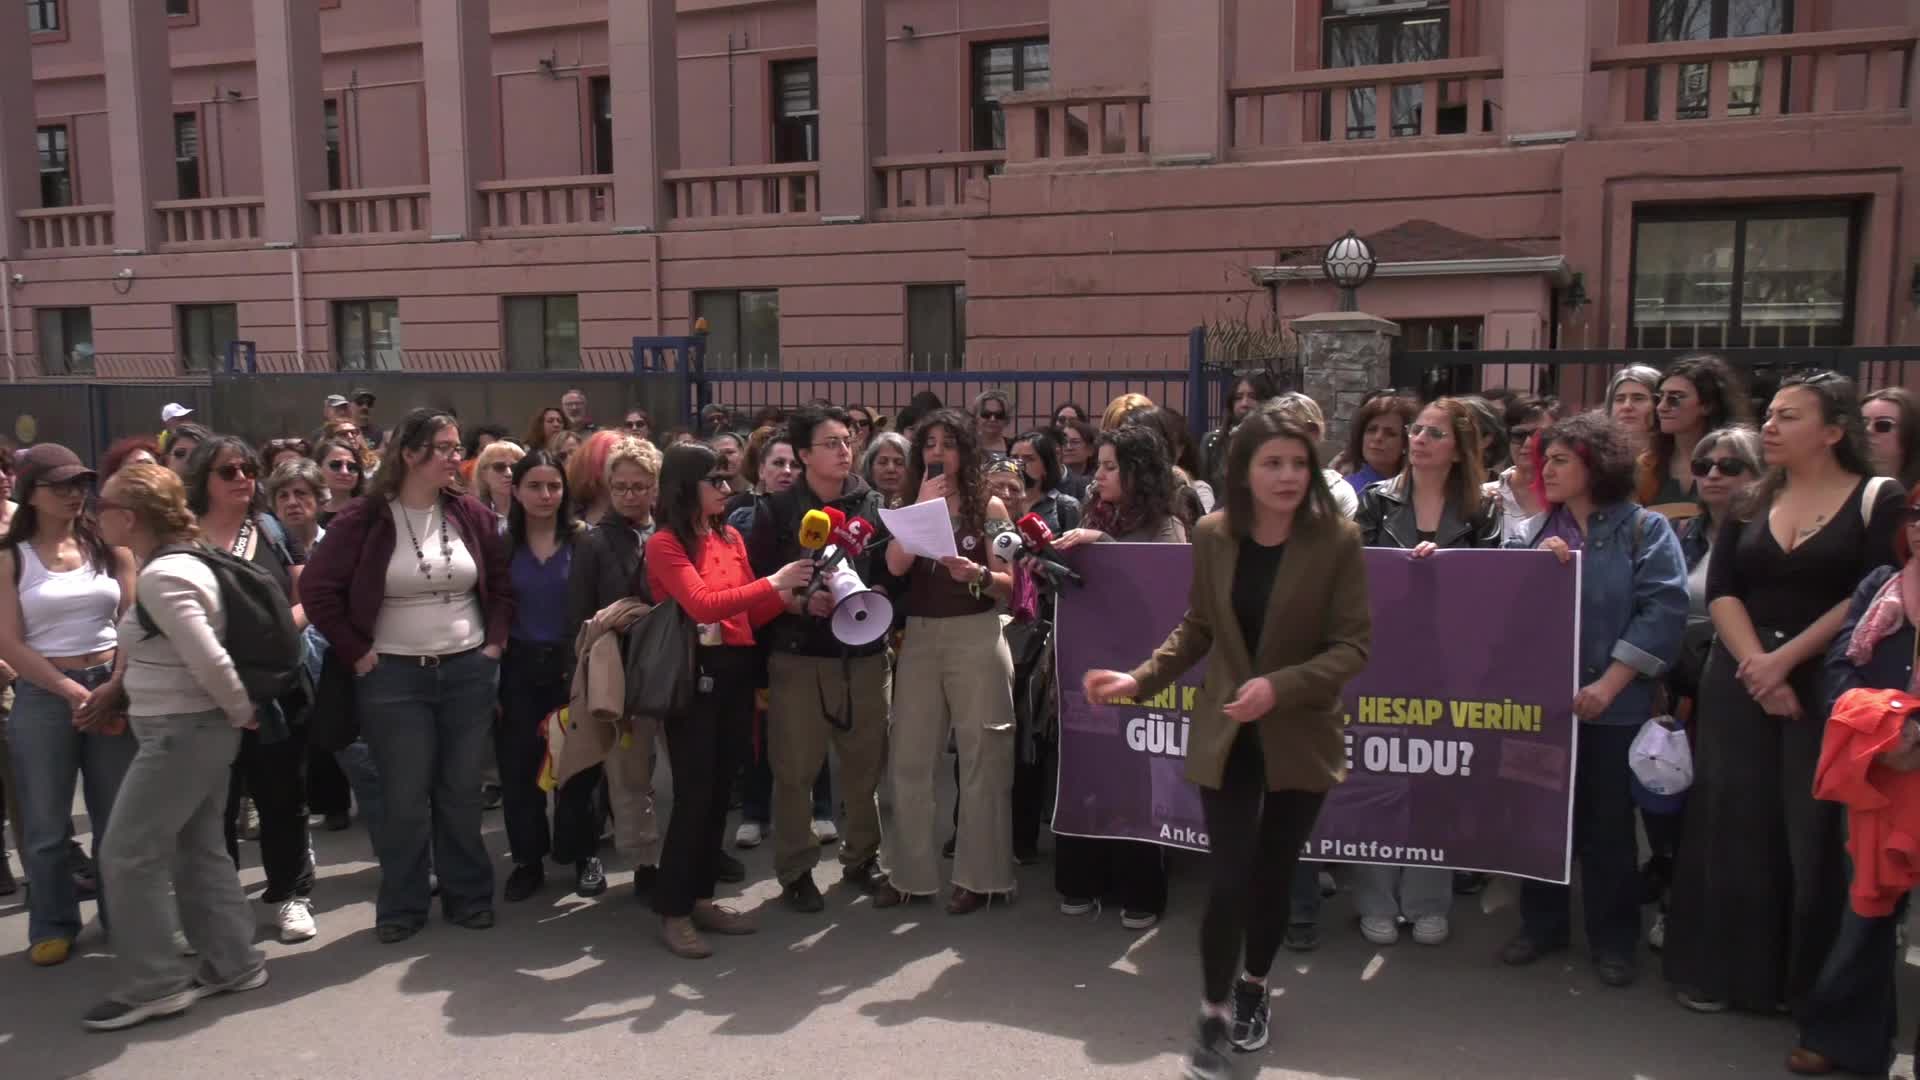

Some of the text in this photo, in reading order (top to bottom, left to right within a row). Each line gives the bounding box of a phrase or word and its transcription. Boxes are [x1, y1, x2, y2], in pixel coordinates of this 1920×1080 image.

[1358, 696, 1542, 732] HESAP VERİN!
[1126, 713, 1190, 757] GÜLİ
[1364, 736, 1475, 776] OLDU?
[1159, 823, 1209, 845] Anka
[1319, 839, 1445, 862] Platformu
